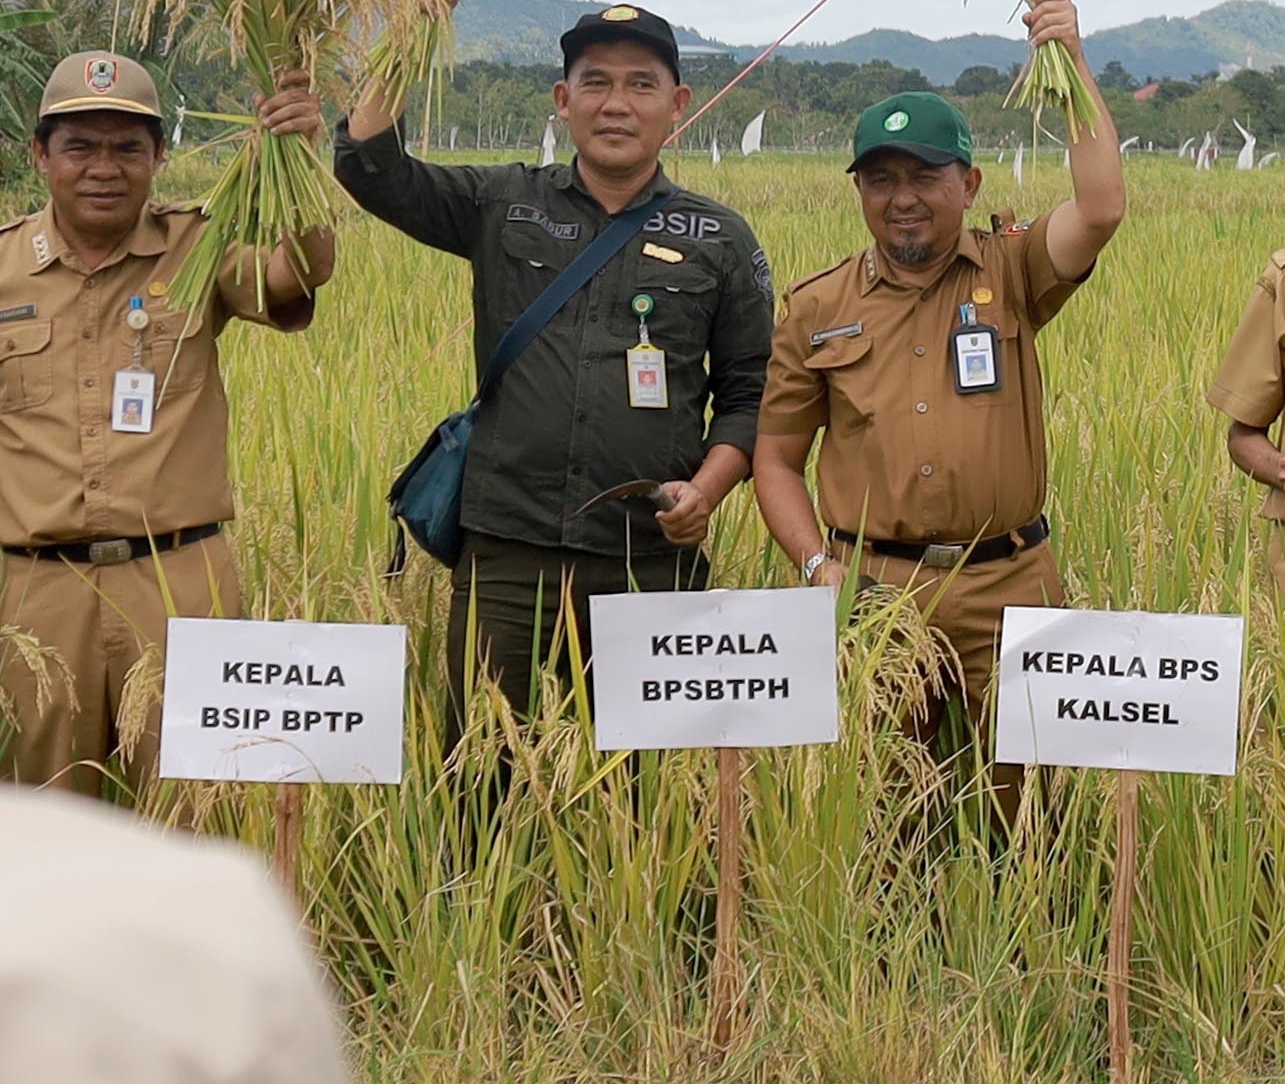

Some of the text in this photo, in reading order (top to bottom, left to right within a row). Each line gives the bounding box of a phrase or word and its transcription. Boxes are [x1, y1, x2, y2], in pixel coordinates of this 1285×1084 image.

[643, 211, 722, 239] BSIP
[651, 633, 778, 657] KEPALA
[222, 661, 345, 687] KEPALA
[1022, 651, 1219, 681] KEPALA BPS
[642, 677, 790, 702] BPSBTPH
[201, 707, 365, 733] BSIP BPTP
[1057, 698, 1180, 725] KALSEL
